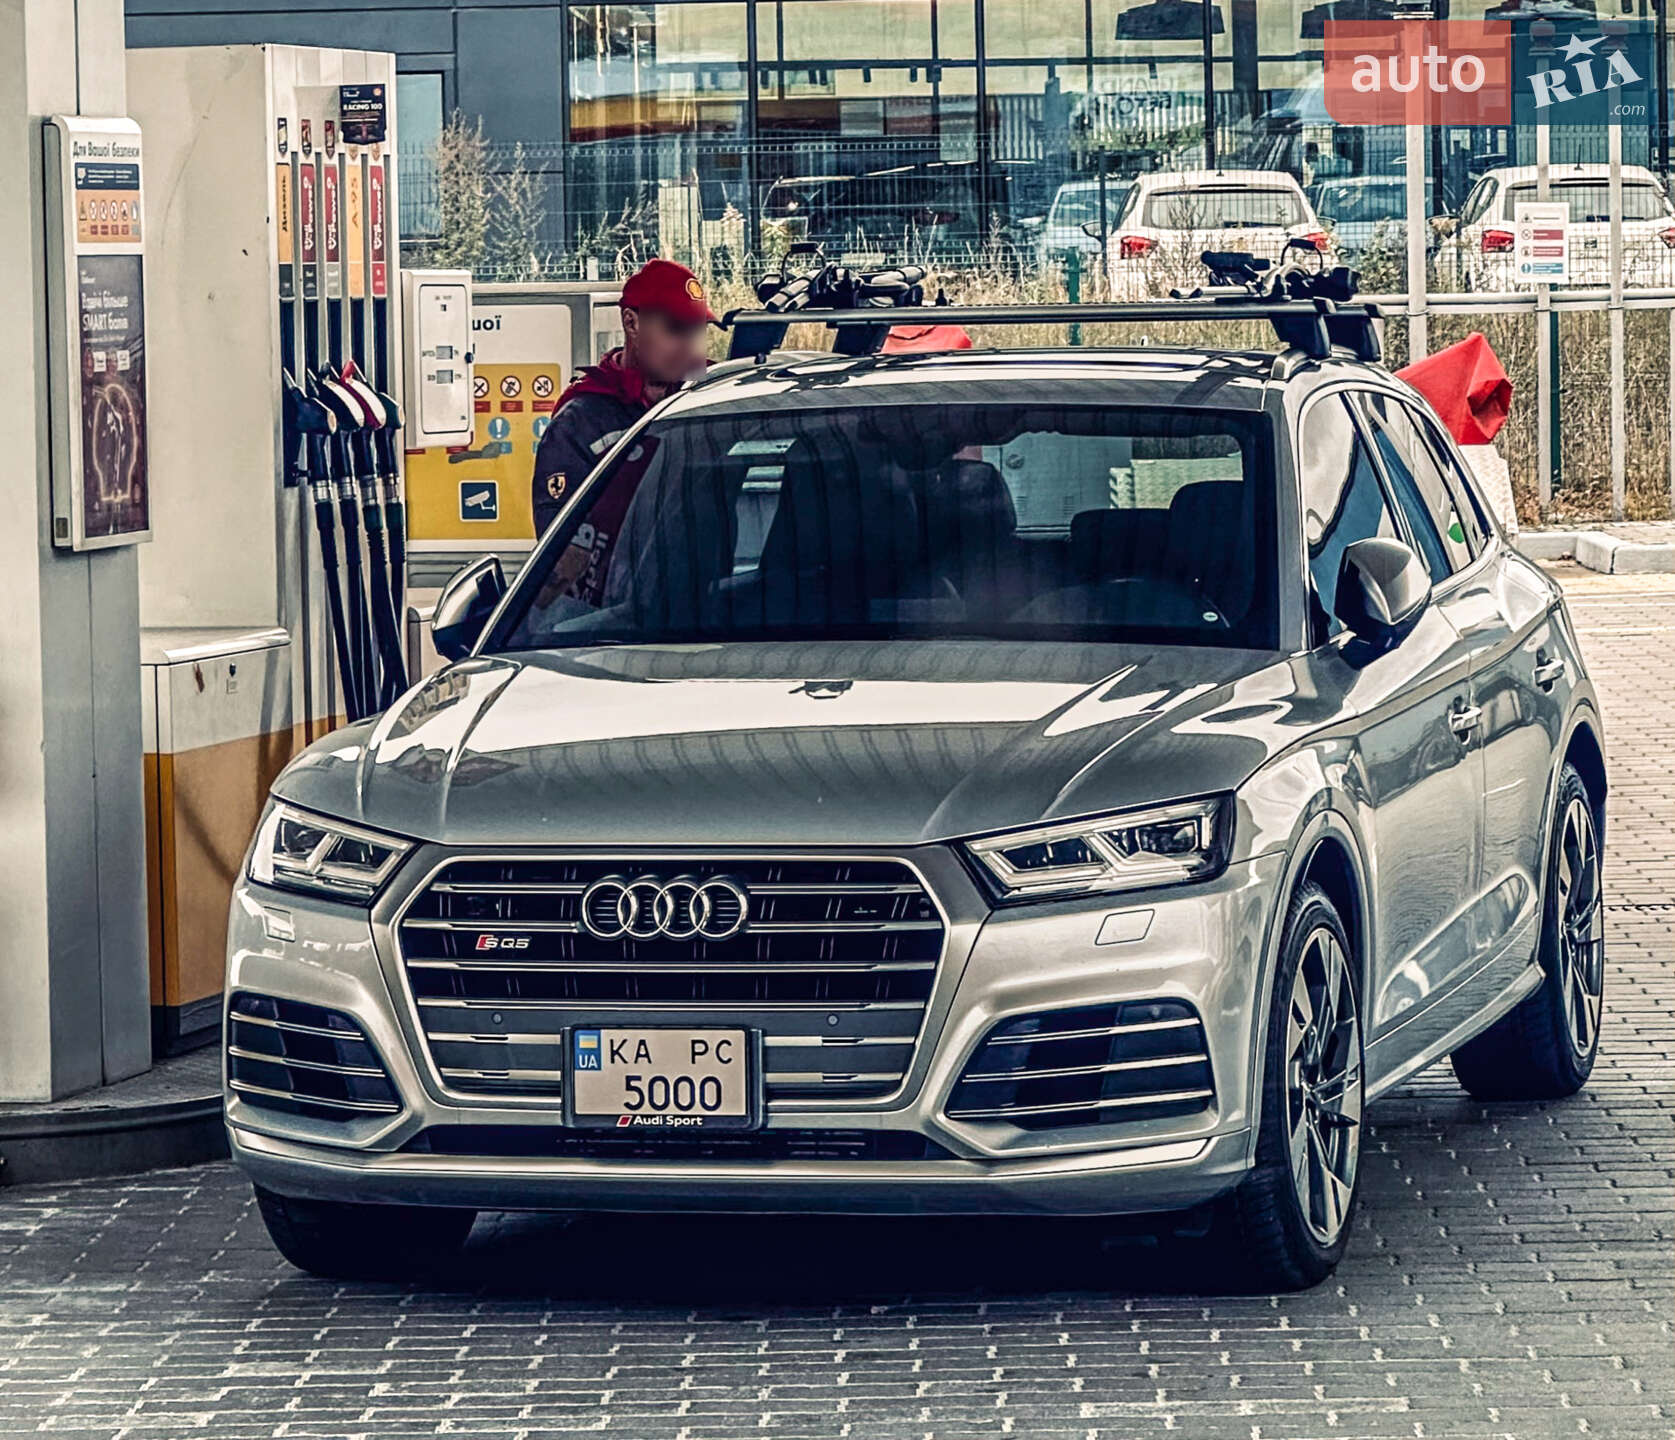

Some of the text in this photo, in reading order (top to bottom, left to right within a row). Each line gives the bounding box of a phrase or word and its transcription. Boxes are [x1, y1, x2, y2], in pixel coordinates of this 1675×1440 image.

[475, 934, 531, 950] SQ5
[609, 1038, 733, 1065] KA PC
[578, 1055, 598, 1069] UA
[623, 1075, 723, 1112] 5000
[633, 1115, 703, 1127] Audi Sport
